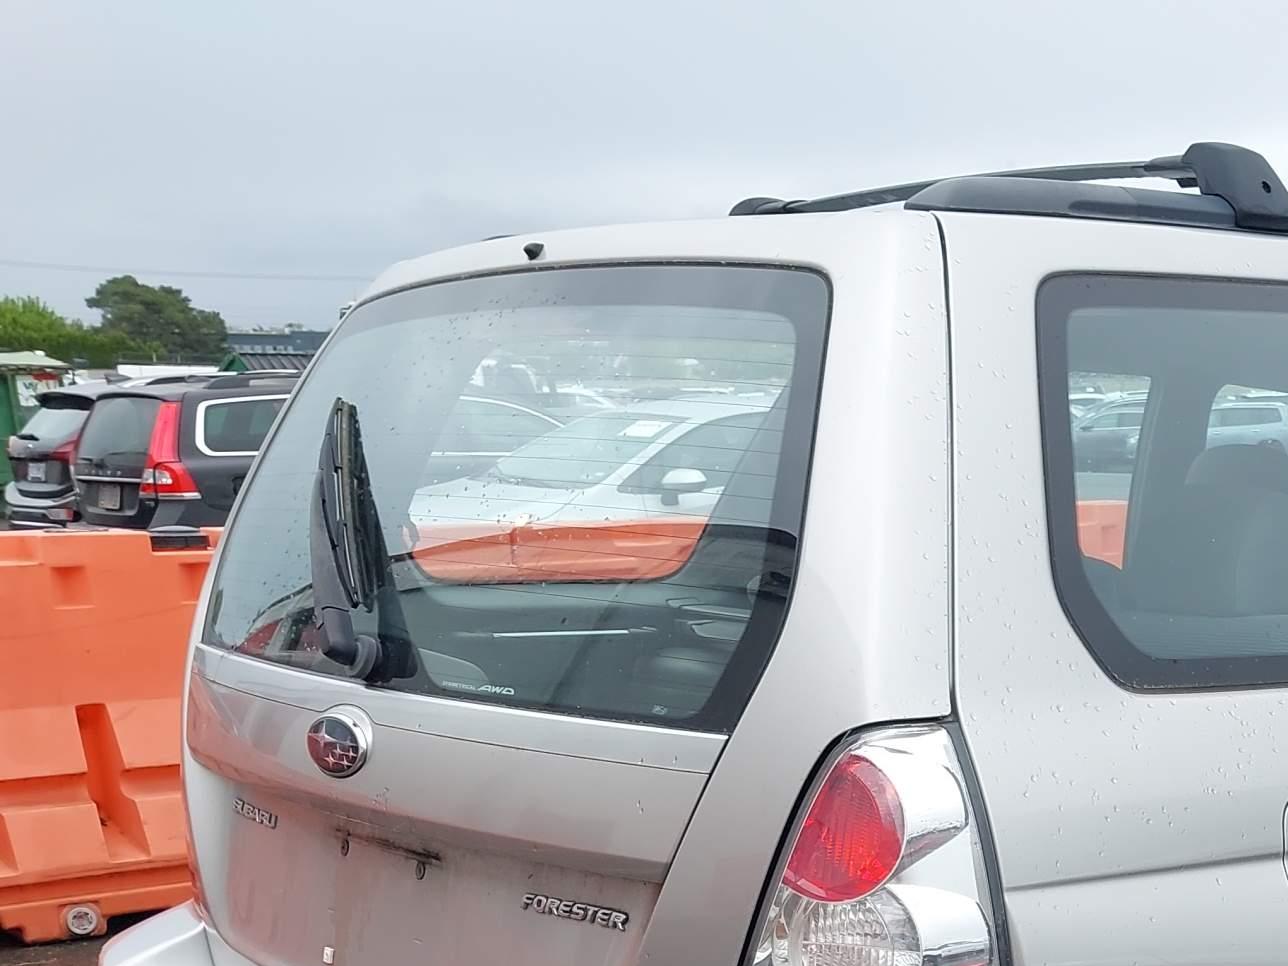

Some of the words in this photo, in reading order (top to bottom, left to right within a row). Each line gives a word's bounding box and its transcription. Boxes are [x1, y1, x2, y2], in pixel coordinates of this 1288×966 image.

[478, 684, 515, 696] AWD
[232, 798, 278, 829] SUBARU
[521, 893, 629, 931] FORESTER
